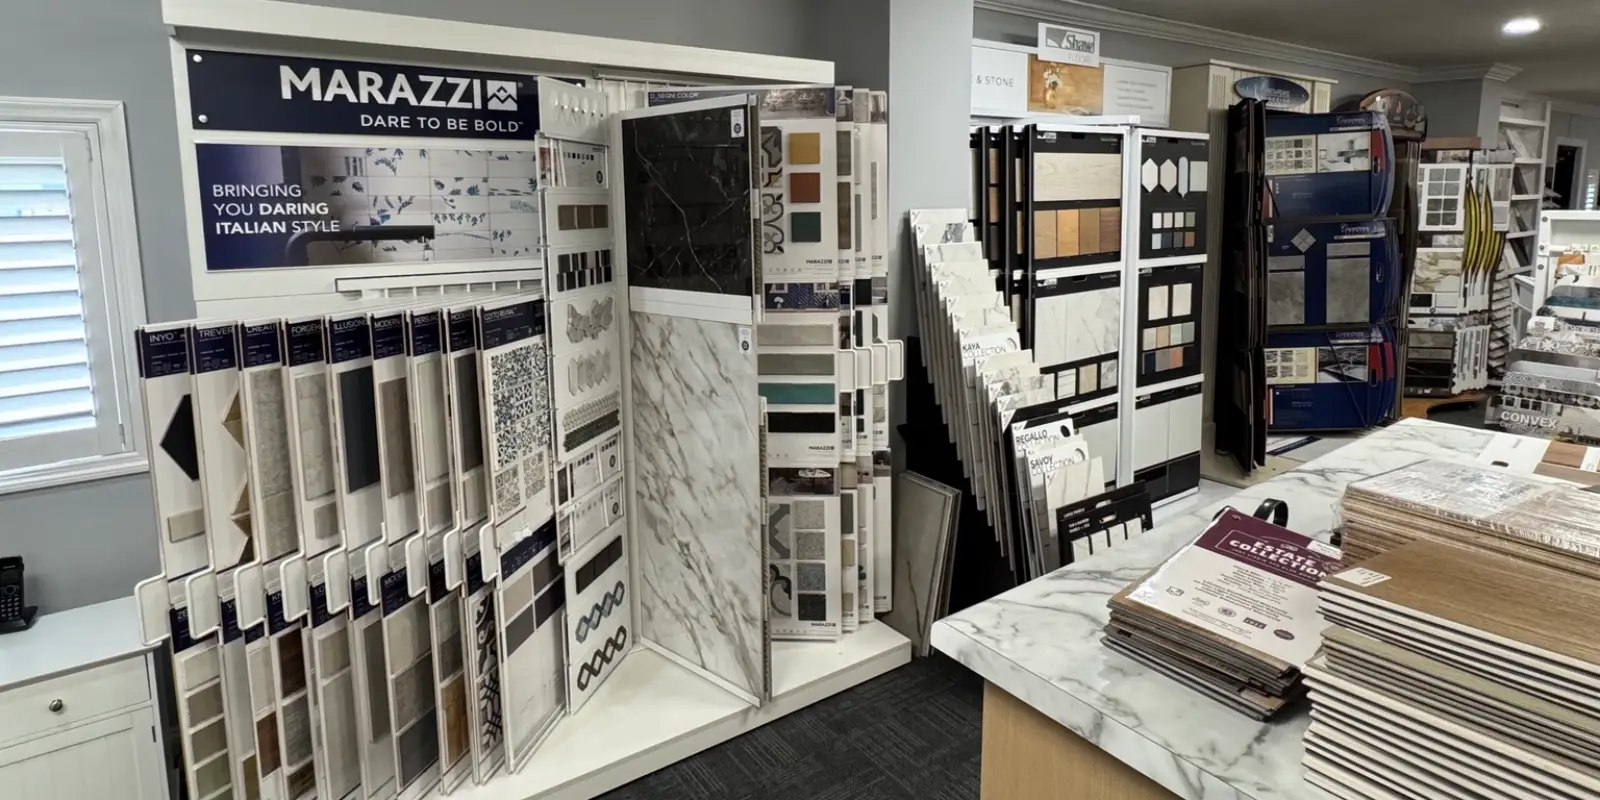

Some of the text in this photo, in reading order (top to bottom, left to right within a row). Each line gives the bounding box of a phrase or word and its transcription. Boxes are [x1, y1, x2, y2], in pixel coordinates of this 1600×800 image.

[1067, 34, 1095, 53] Shaw
[279, 65, 482, 109] MARAZZI
[985, 75, 1014, 88] STONE
[360, 114, 411, 128] DARE
[417, 117, 440, 130] TO
[447, 118, 468, 131] BE
[212, 184, 302, 198] BRINGING
[213, 202, 329, 217] YOU DARING
[215, 220, 341, 235] ITALIAN STYLE
[963, 343, 980, 352] KAYA
[1501, 411, 1559, 428] CONVEX
[1016, 429, 1048, 444] REGALLO
[1030, 455, 1053, 469] SAVOY
[1254, 541, 1316, 567] ESTATE
